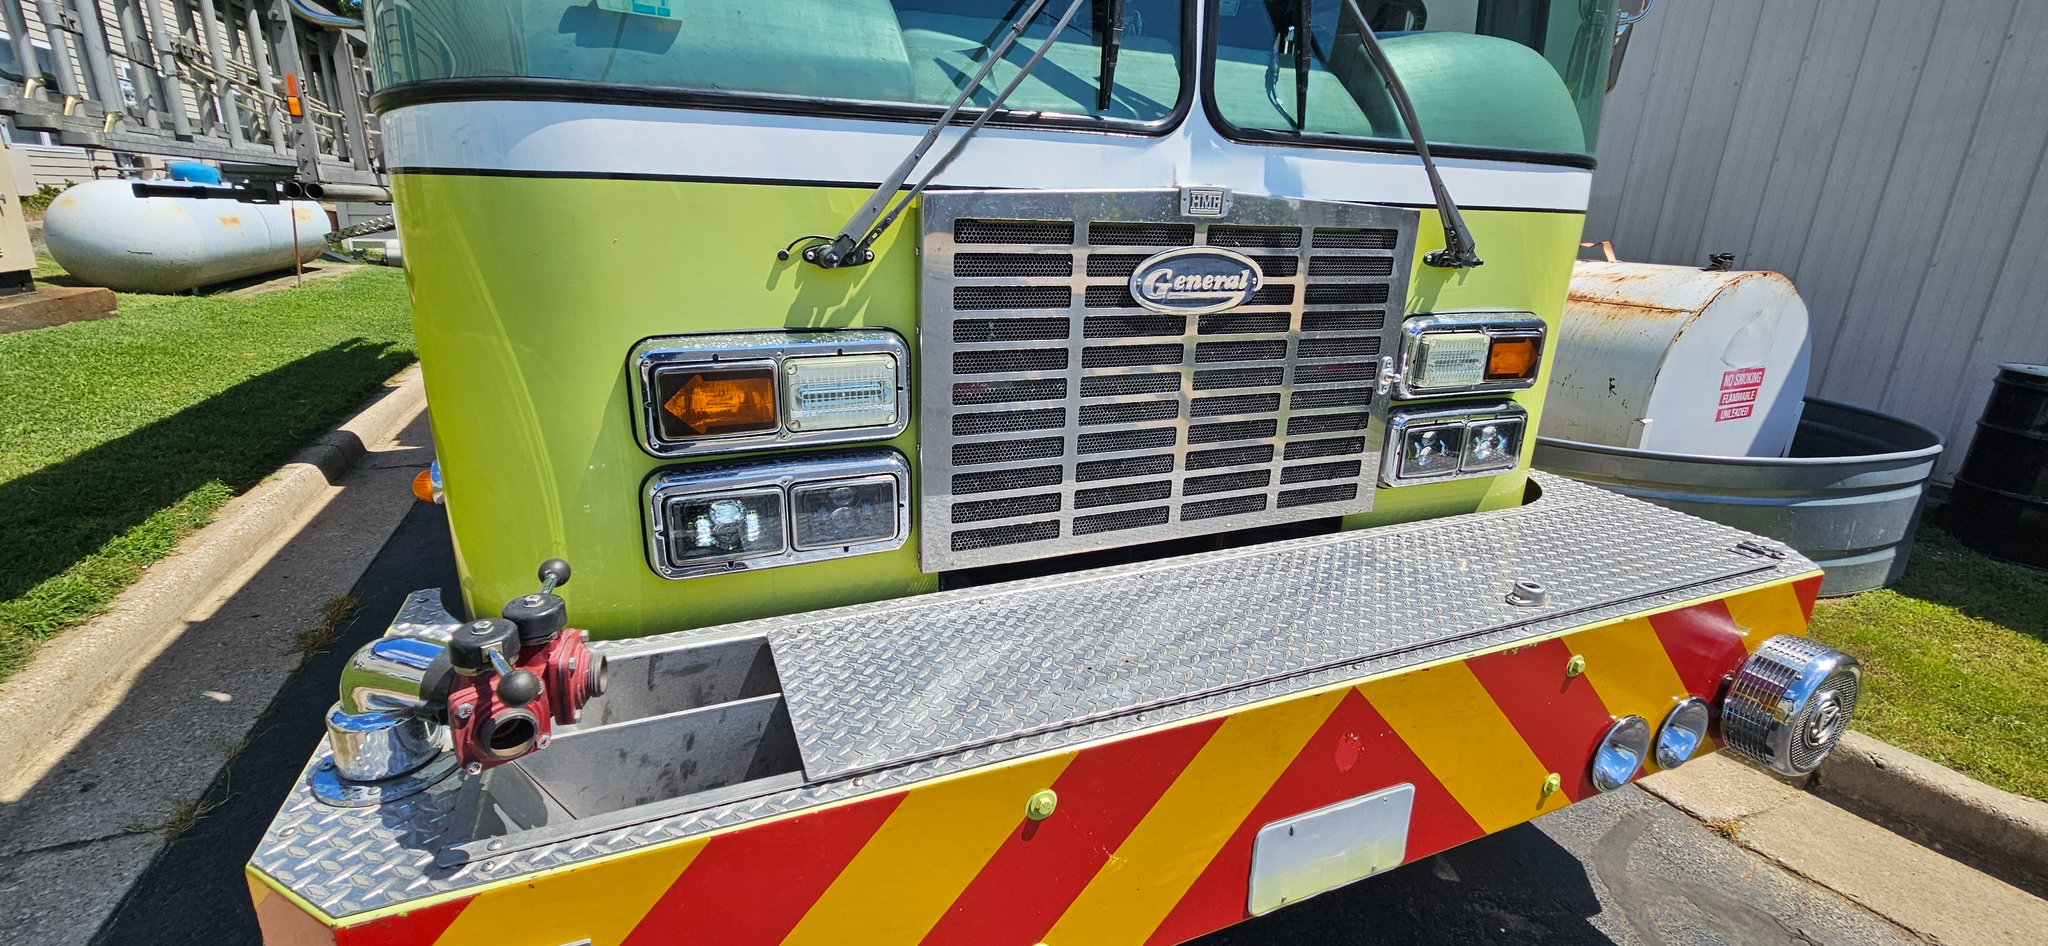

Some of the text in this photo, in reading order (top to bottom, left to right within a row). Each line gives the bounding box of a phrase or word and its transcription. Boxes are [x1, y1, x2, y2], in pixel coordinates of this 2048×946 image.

[1190, 194, 1221, 209] HME
[1142, 268, 1250, 299] General
[1723, 371, 1762, 387] NO SMOKING
[1721, 390, 1756, 404] FLAMMABLE
[1720, 407, 1750, 420] UNLEADED
